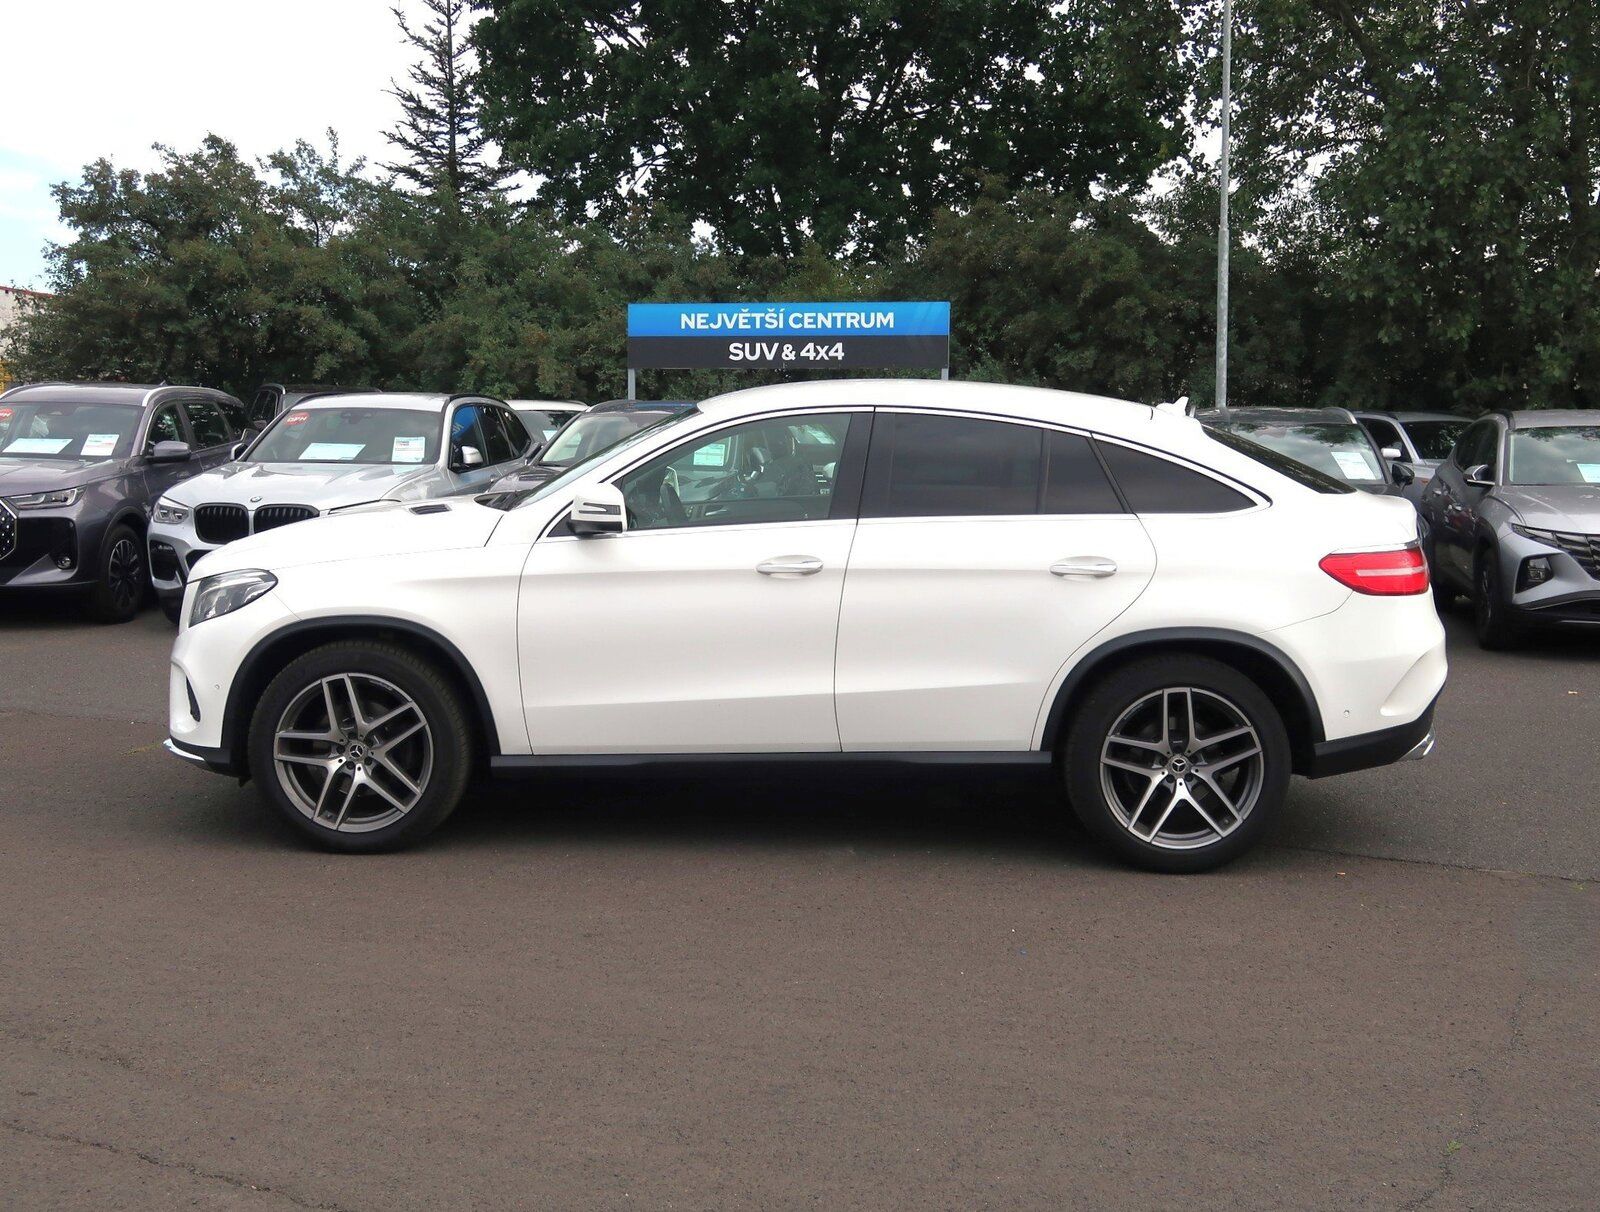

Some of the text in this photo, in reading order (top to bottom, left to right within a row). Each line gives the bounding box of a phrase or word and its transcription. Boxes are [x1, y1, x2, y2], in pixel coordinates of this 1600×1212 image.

[681, 308, 894, 329] NEJVĚTŠÍ CENTRUM
[728, 343, 845, 361] SUV & 4x4
